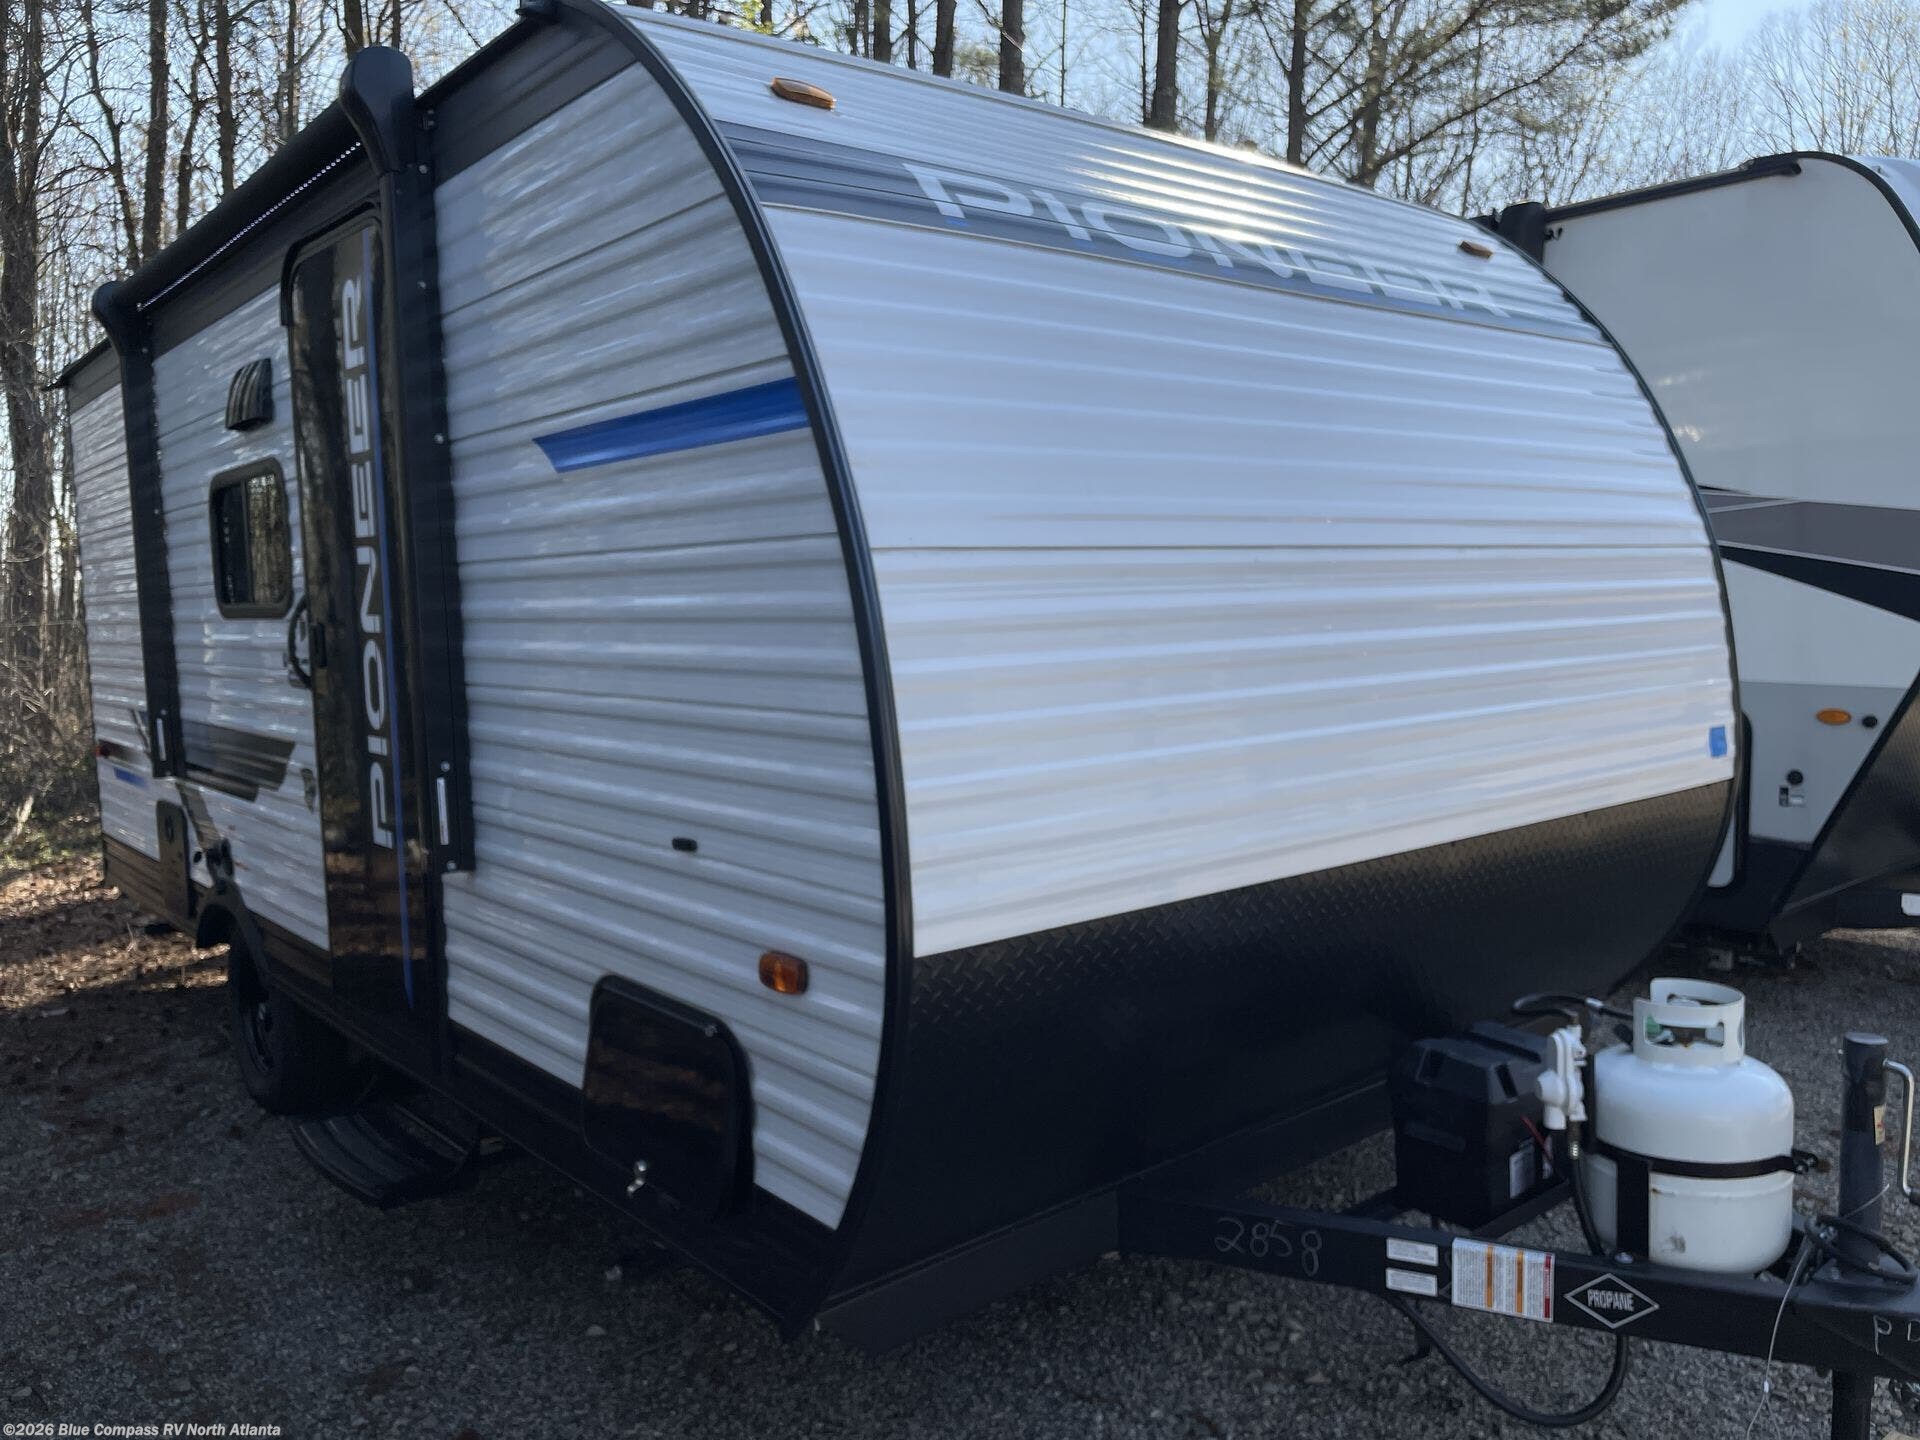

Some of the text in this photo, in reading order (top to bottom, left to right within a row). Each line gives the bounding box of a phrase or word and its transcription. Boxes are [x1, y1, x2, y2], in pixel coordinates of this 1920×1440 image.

[902, 161, 1512, 319] PIONEER
[340, 276, 395, 850] PIONEER
[1214, 1216, 1323, 1277] 2858
[1587, 1289, 1635, 1312] PROPANE
